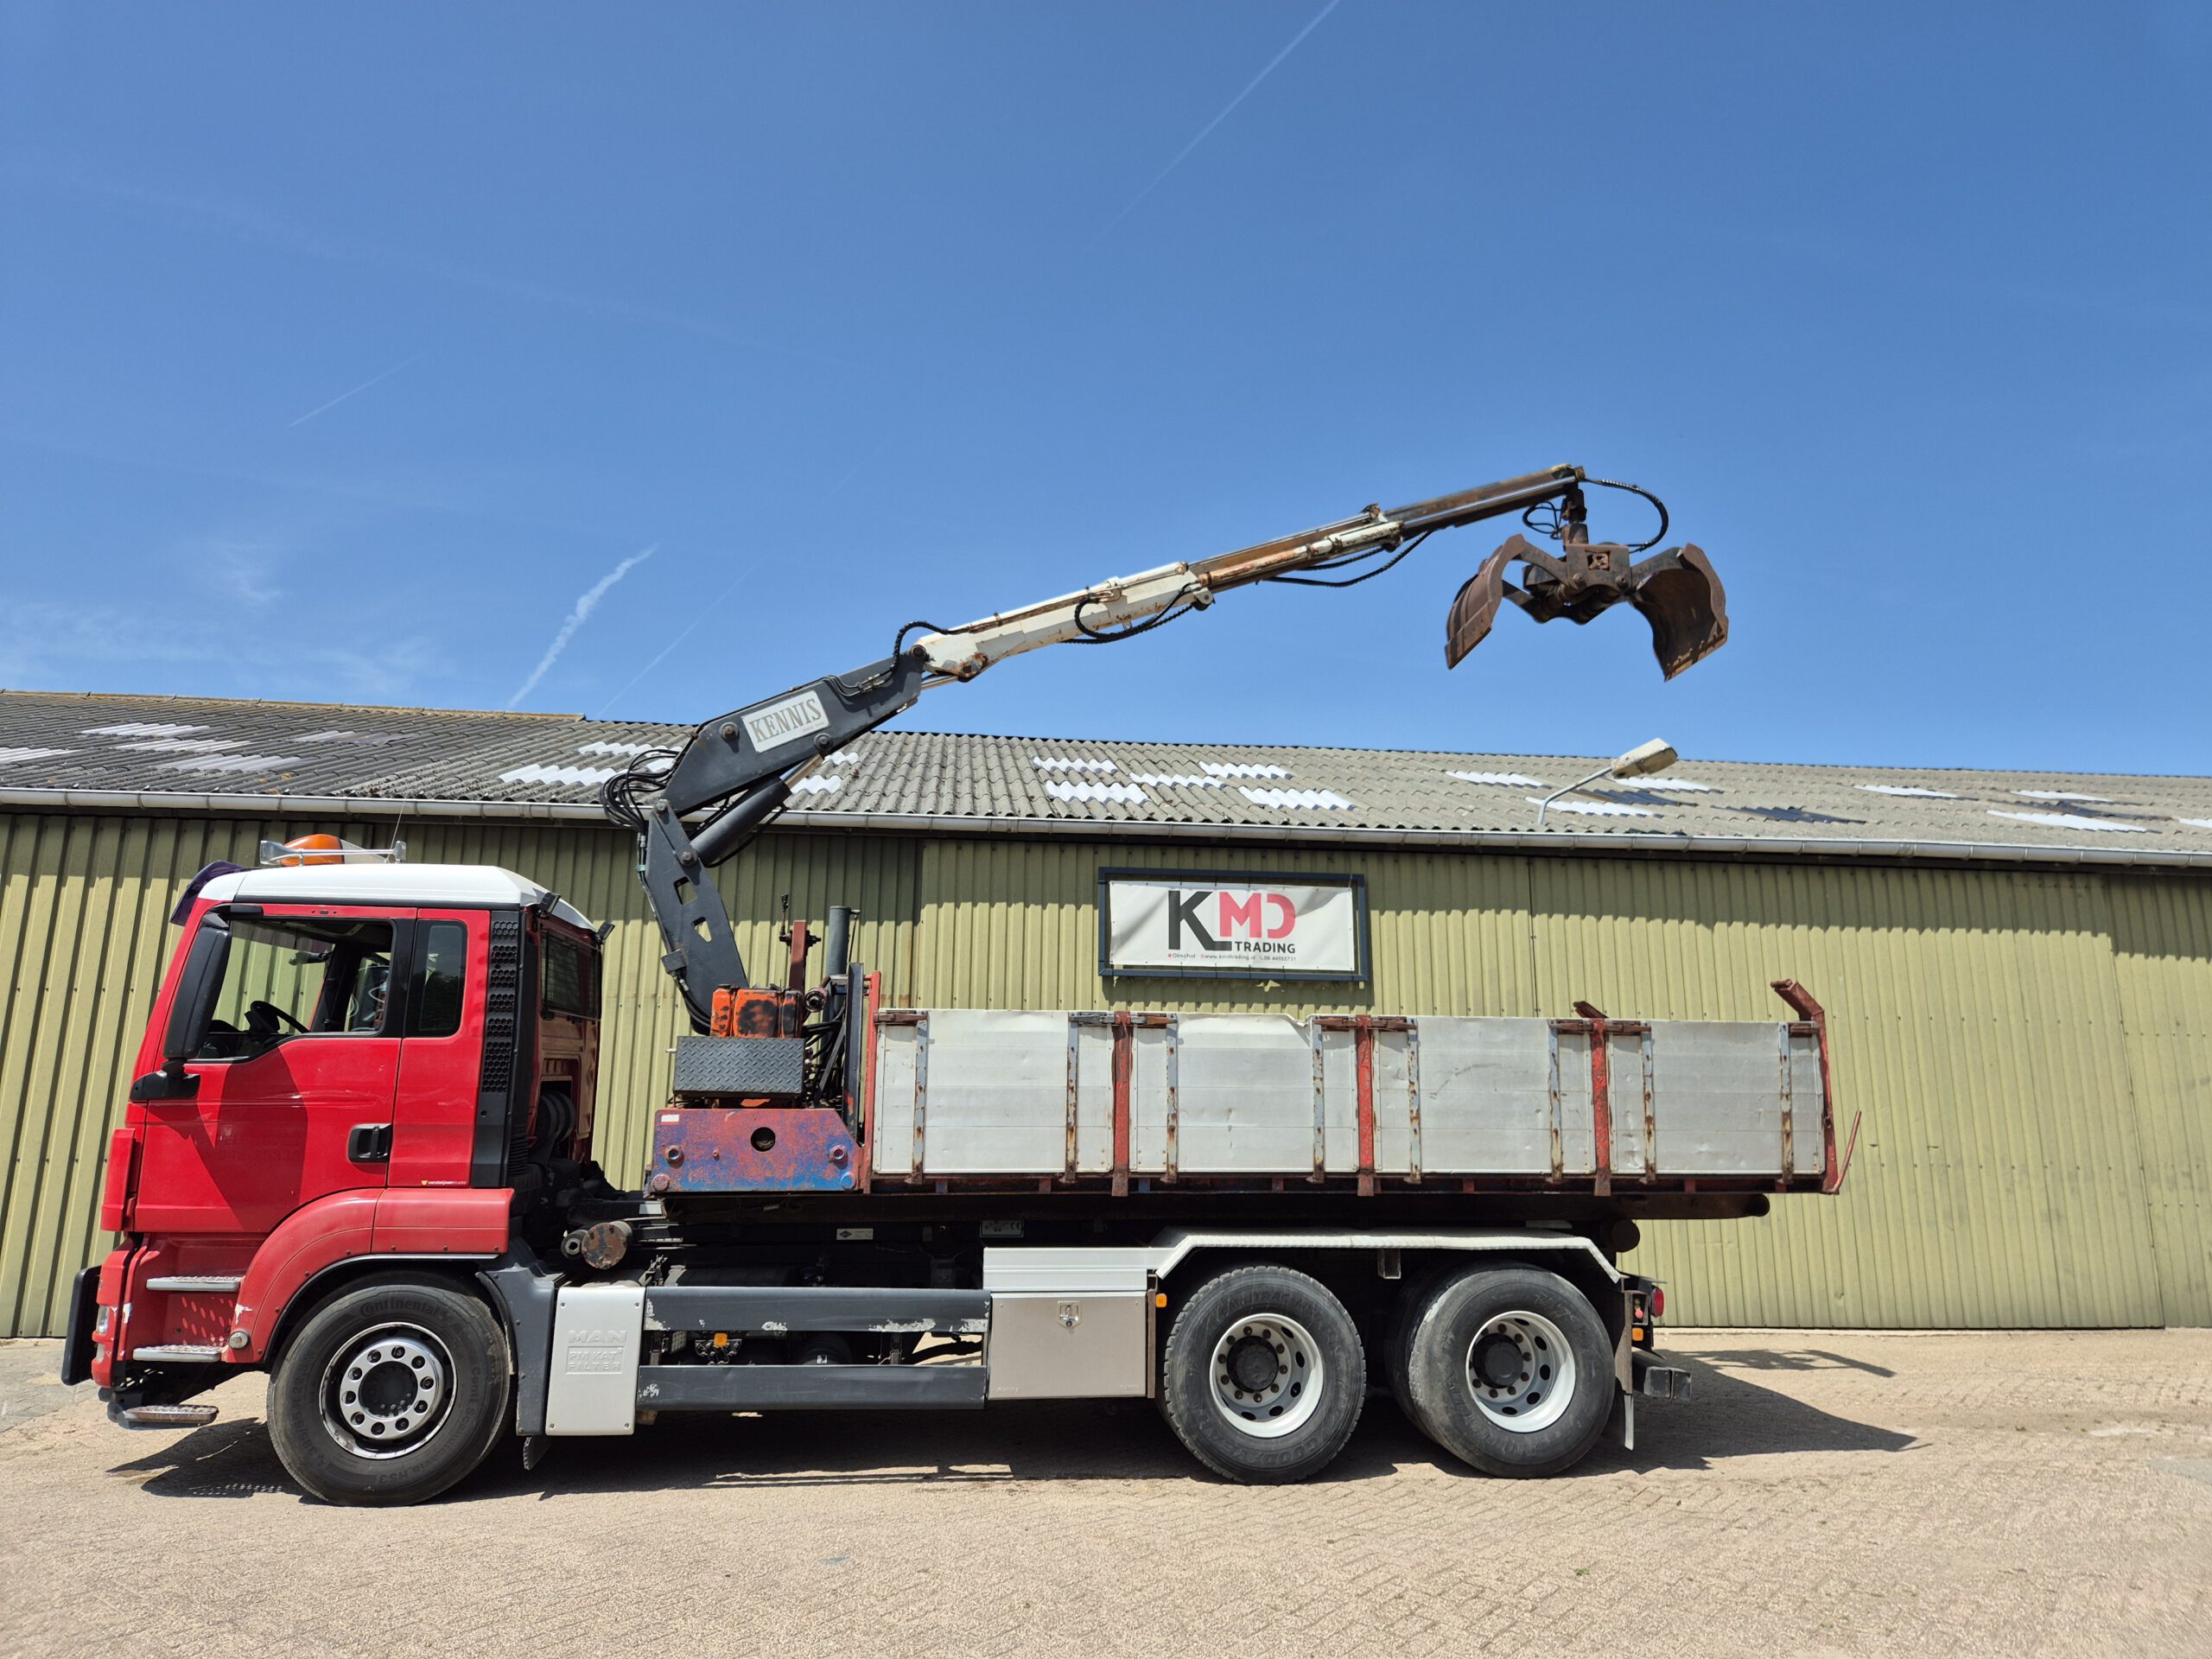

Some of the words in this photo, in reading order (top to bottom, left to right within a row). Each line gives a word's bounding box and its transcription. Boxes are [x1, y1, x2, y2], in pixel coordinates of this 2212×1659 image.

[749, 699, 821, 743] KENNIS
[1168, 890, 1296, 950] KMD
[1235, 942, 1295, 953] TRADING
[360, 1299, 438, 1317] Continental
[568, 1330, 626, 1344] MAN
[569, 1351, 590, 1361] PM
[568, 1362, 621, 1371] FILTER
